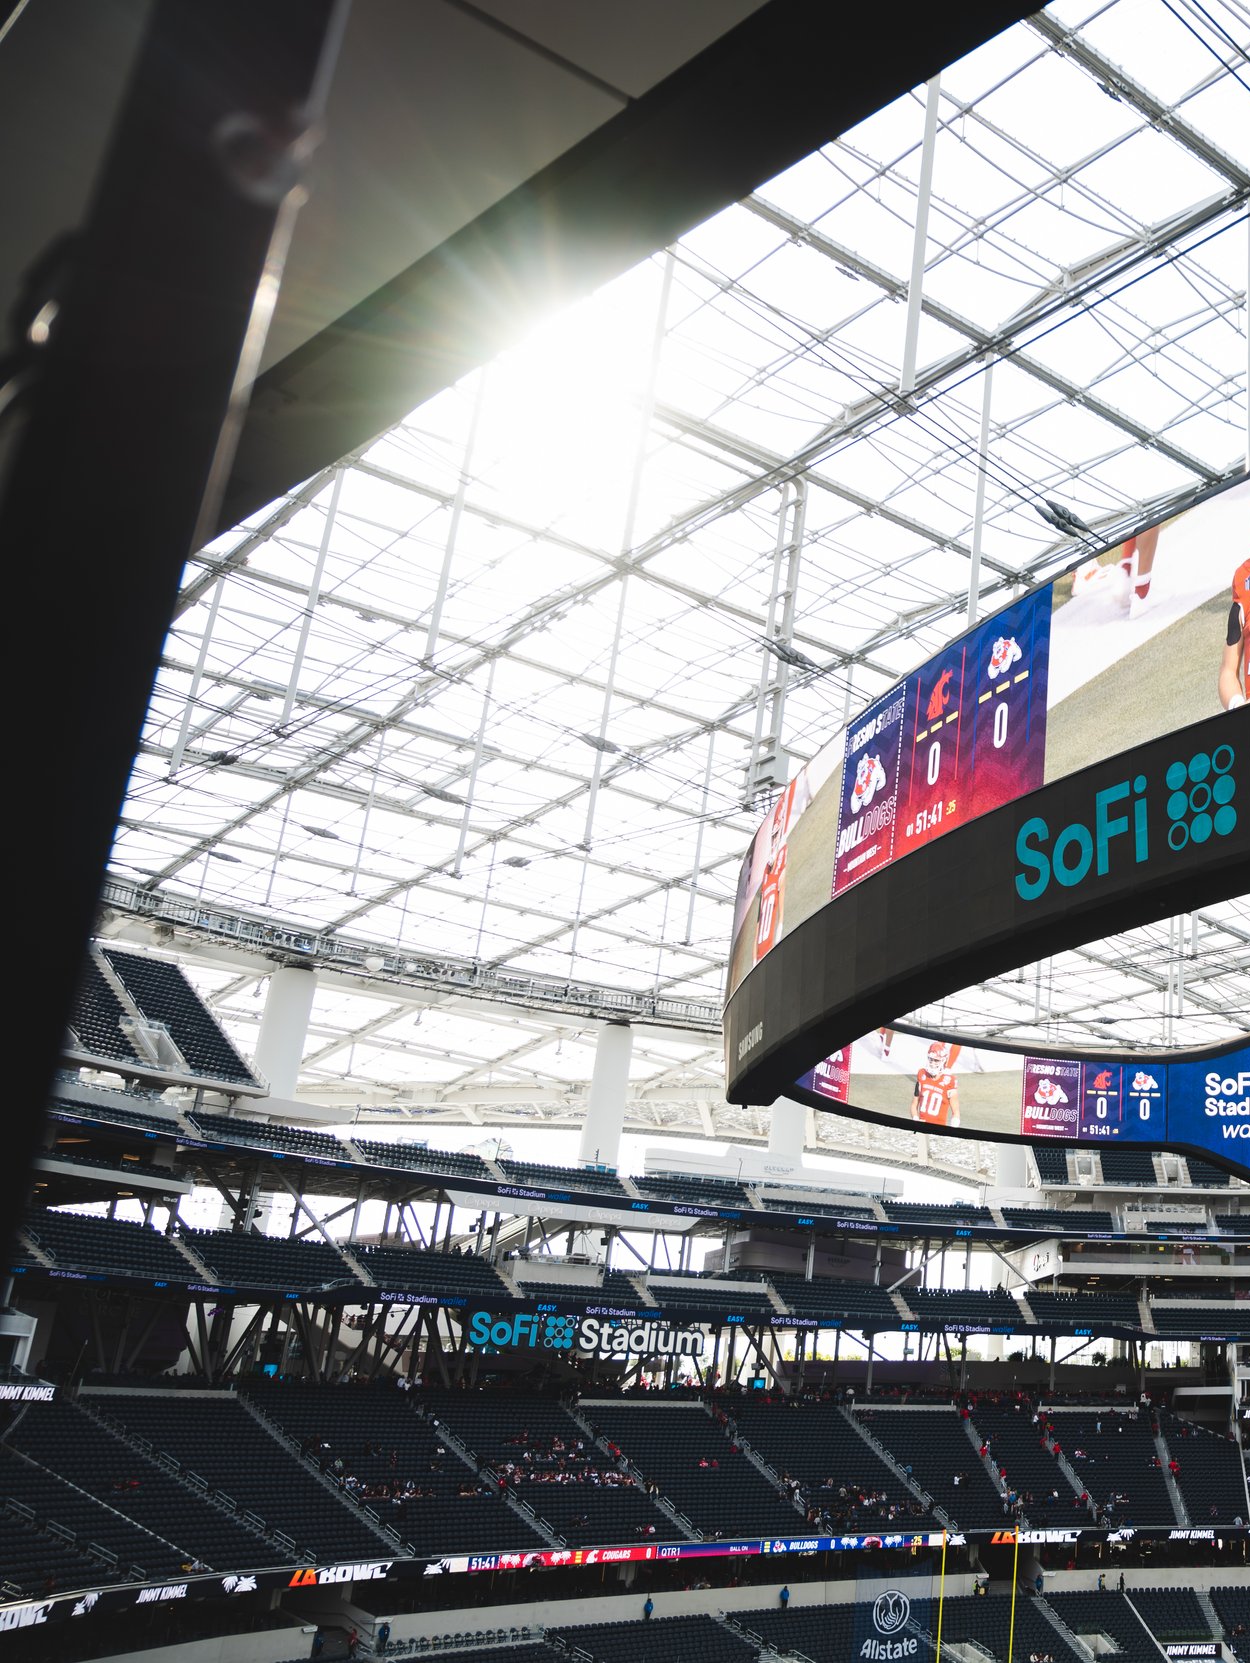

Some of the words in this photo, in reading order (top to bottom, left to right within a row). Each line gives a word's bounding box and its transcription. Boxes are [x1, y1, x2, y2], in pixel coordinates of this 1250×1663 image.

[847, 718, 877, 758] FRESNO
[876, 698, 904, 735] STATE
[993, 702, 1009, 748] 0
[927, 741, 941, 785] 0
[915, 801, 943, 834] 51:41
[837, 796, 897, 858] BULLDOGS
[1014, 774, 1150, 900] SoFi
[758, 894, 775, 944] 10
[738, 1021, 763, 1061] SAMSUNG
[1027, 1064, 1056, 1076] FRESNO
[1056, 1066, 1079, 1078] STATE
[920, 1090, 943, 1116] 10
[1096, 1097, 1107, 1119] 0
[1139, 1098, 1150, 1120] 0
[1025, 1106, 1078, 1122] BULLDOGS
[1089, 1125, 1110, 1135] 51:41
[497, 1186, 511, 1195] SoFi
[519, 1188, 546, 1199] Stadium
[632, 1202, 649, 1210] EASY.
[673, 1205, 688, 1214] SoFi
[693, 1207, 718, 1217] Stadium
[836, 1221, 849, 1229] SoFi
[855, 1222, 878, 1231] Stadium
[956, 1229, 972, 1237] EASY.
[380, 1292, 396, 1300] SoFi
[406, 1294, 437, 1304] Stadium
[586, 1305, 600, 1314] SoFi
[608, 1307, 636, 1317] Stadium
[771, 1317, 785, 1325] SoFi
[792, 1318, 818, 1326] Stadium
[901, 1323, 919, 1331] EASY.
[470, 1311, 539, 1347] SoFi
[578, 1318, 704, 1355] Stadium
[944, 1324, 958, 1332] SoFi
[965, 1325, 991, 1333] Stadium
[1075, 1328, 1093, 1336] EASY.
[21, 1386, 55, 1401] KIMMEL
[911, 1536, 922, 1546] :25
[991, 1531, 1017, 1544] LA
[1168, 1530, 1189, 1539] JIMMY
[1189, 1530, 1215, 1539] KIMMEL
[789, 1540, 818, 1550] BULLDOGS
[830, 1539, 836, 1549] 0
[602, 1550, 631, 1560] COUGARS
[646, 1548, 651, 1558] 0
[661, 1547, 680, 1556] QTR1
[471, 1556, 495, 1569] 51:41
[288, 1568, 317, 1587] LA
[317, 1562, 393, 1585] BOWL
[136, 1588, 162, 1604] JIMMY
[160, 1584, 188, 1601] KIMMEL
[860, 1638, 918, 1660] Allstate
[1166, 1645, 1189, 1655] JIMMY
[1189, 1644, 1216, 1655] KIMMEL
